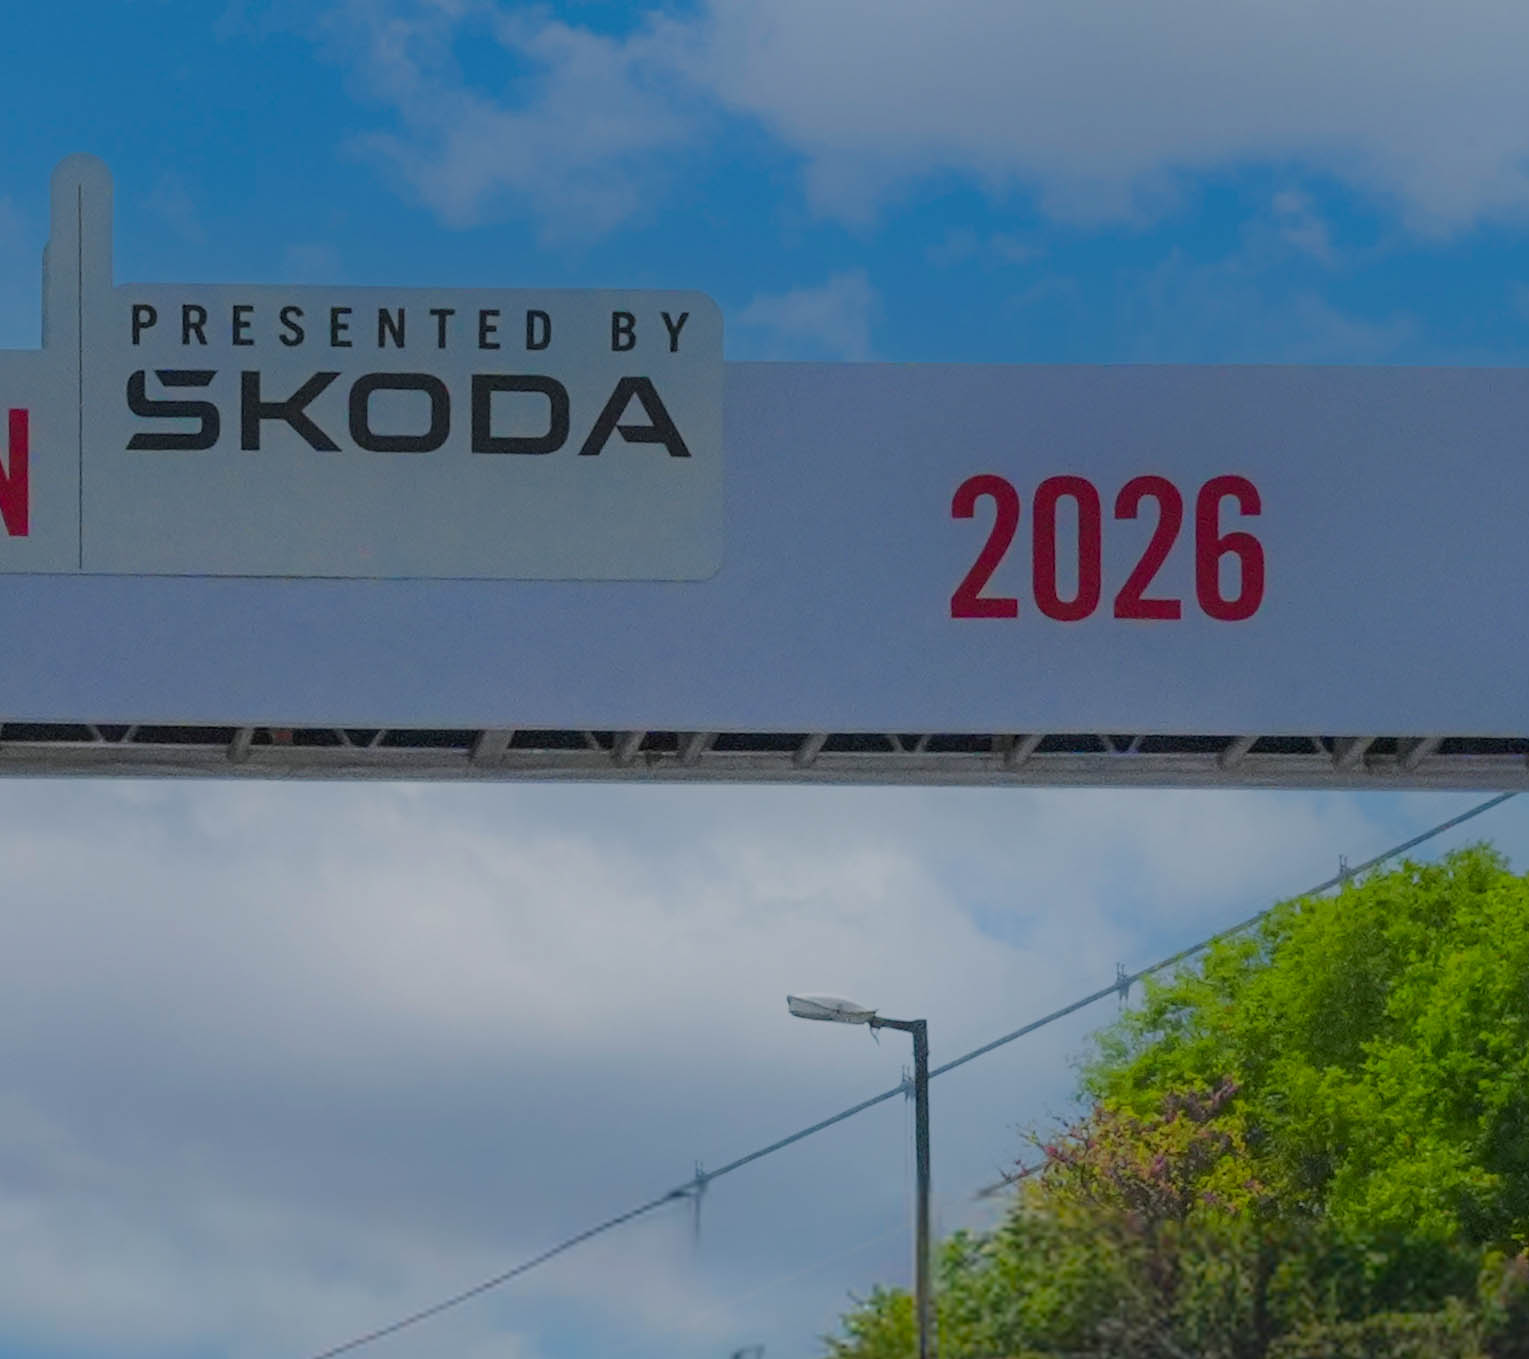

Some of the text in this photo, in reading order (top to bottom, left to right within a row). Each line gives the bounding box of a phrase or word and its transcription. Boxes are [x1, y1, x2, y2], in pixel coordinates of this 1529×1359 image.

[131, 303, 692, 353] PRESENTED BY
[950, 473, 1267, 623] 2026
